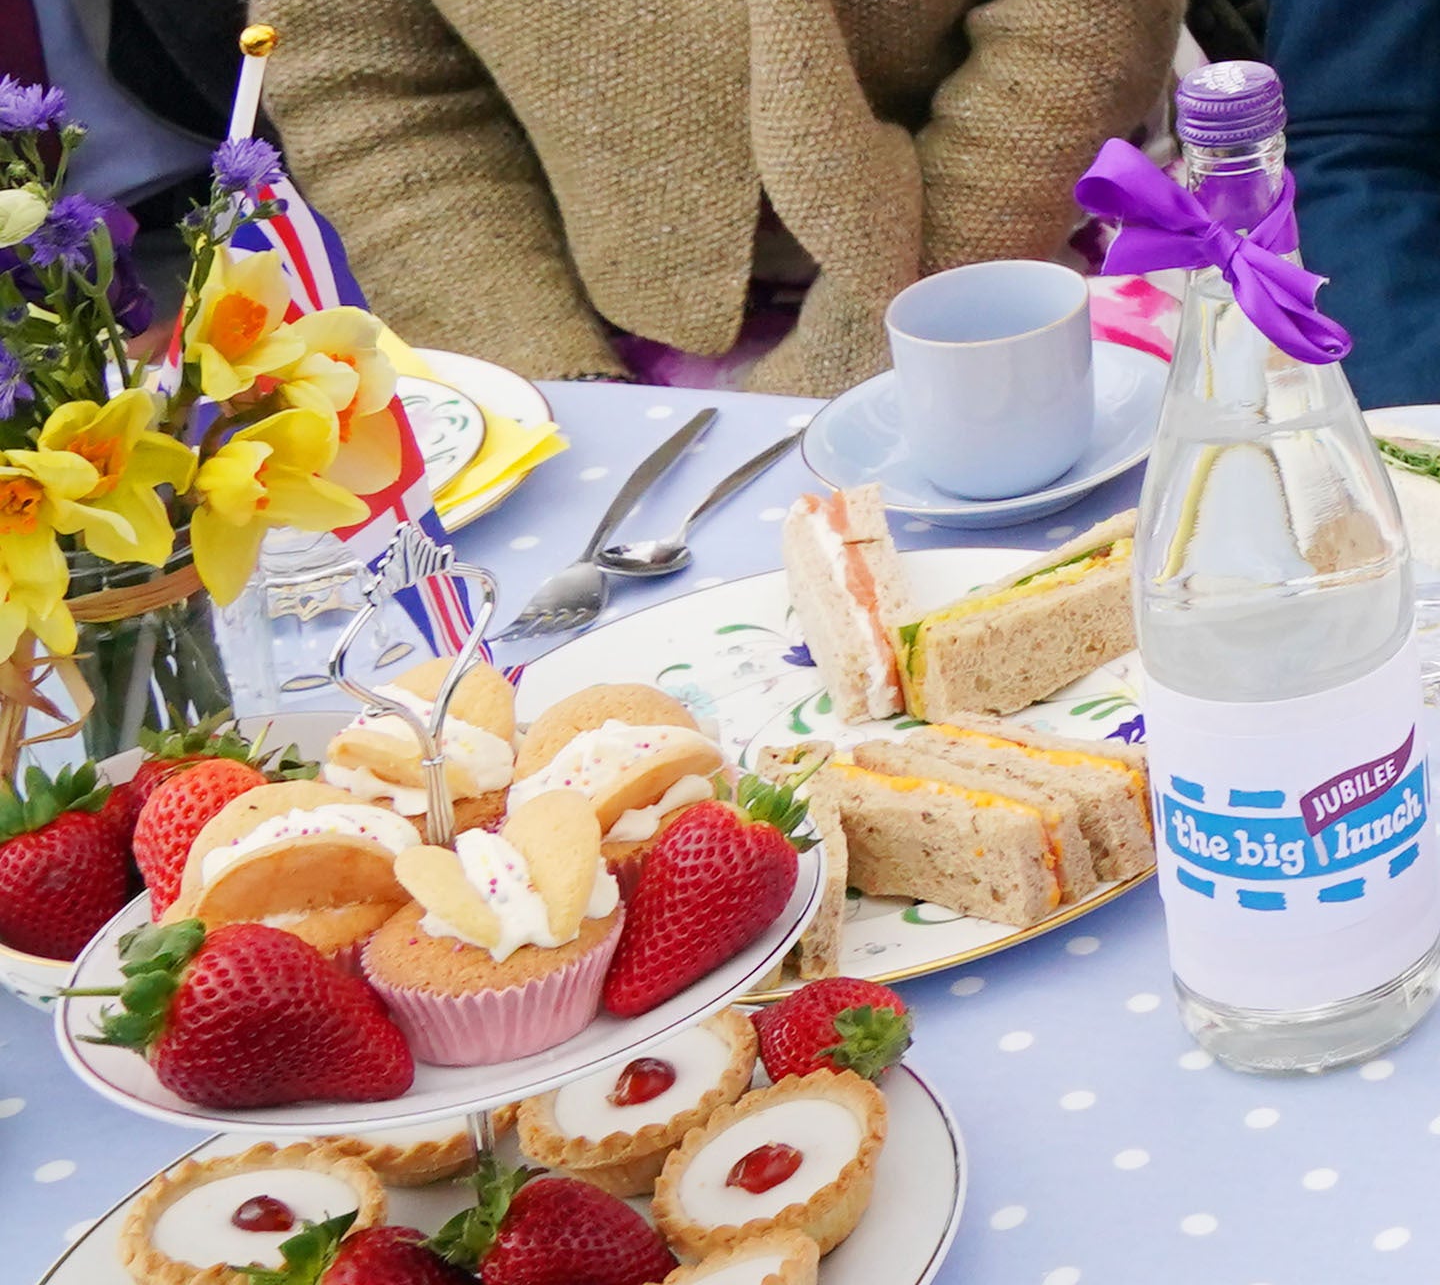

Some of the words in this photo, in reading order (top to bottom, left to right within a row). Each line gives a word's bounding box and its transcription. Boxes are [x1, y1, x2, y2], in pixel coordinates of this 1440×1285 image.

[1311, 758, 1398, 822] JUBILEE
[1171, 810, 1231, 862] the
[1236, 830, 1305, 875] big
[1334, 788, 1423, 860] lunch
